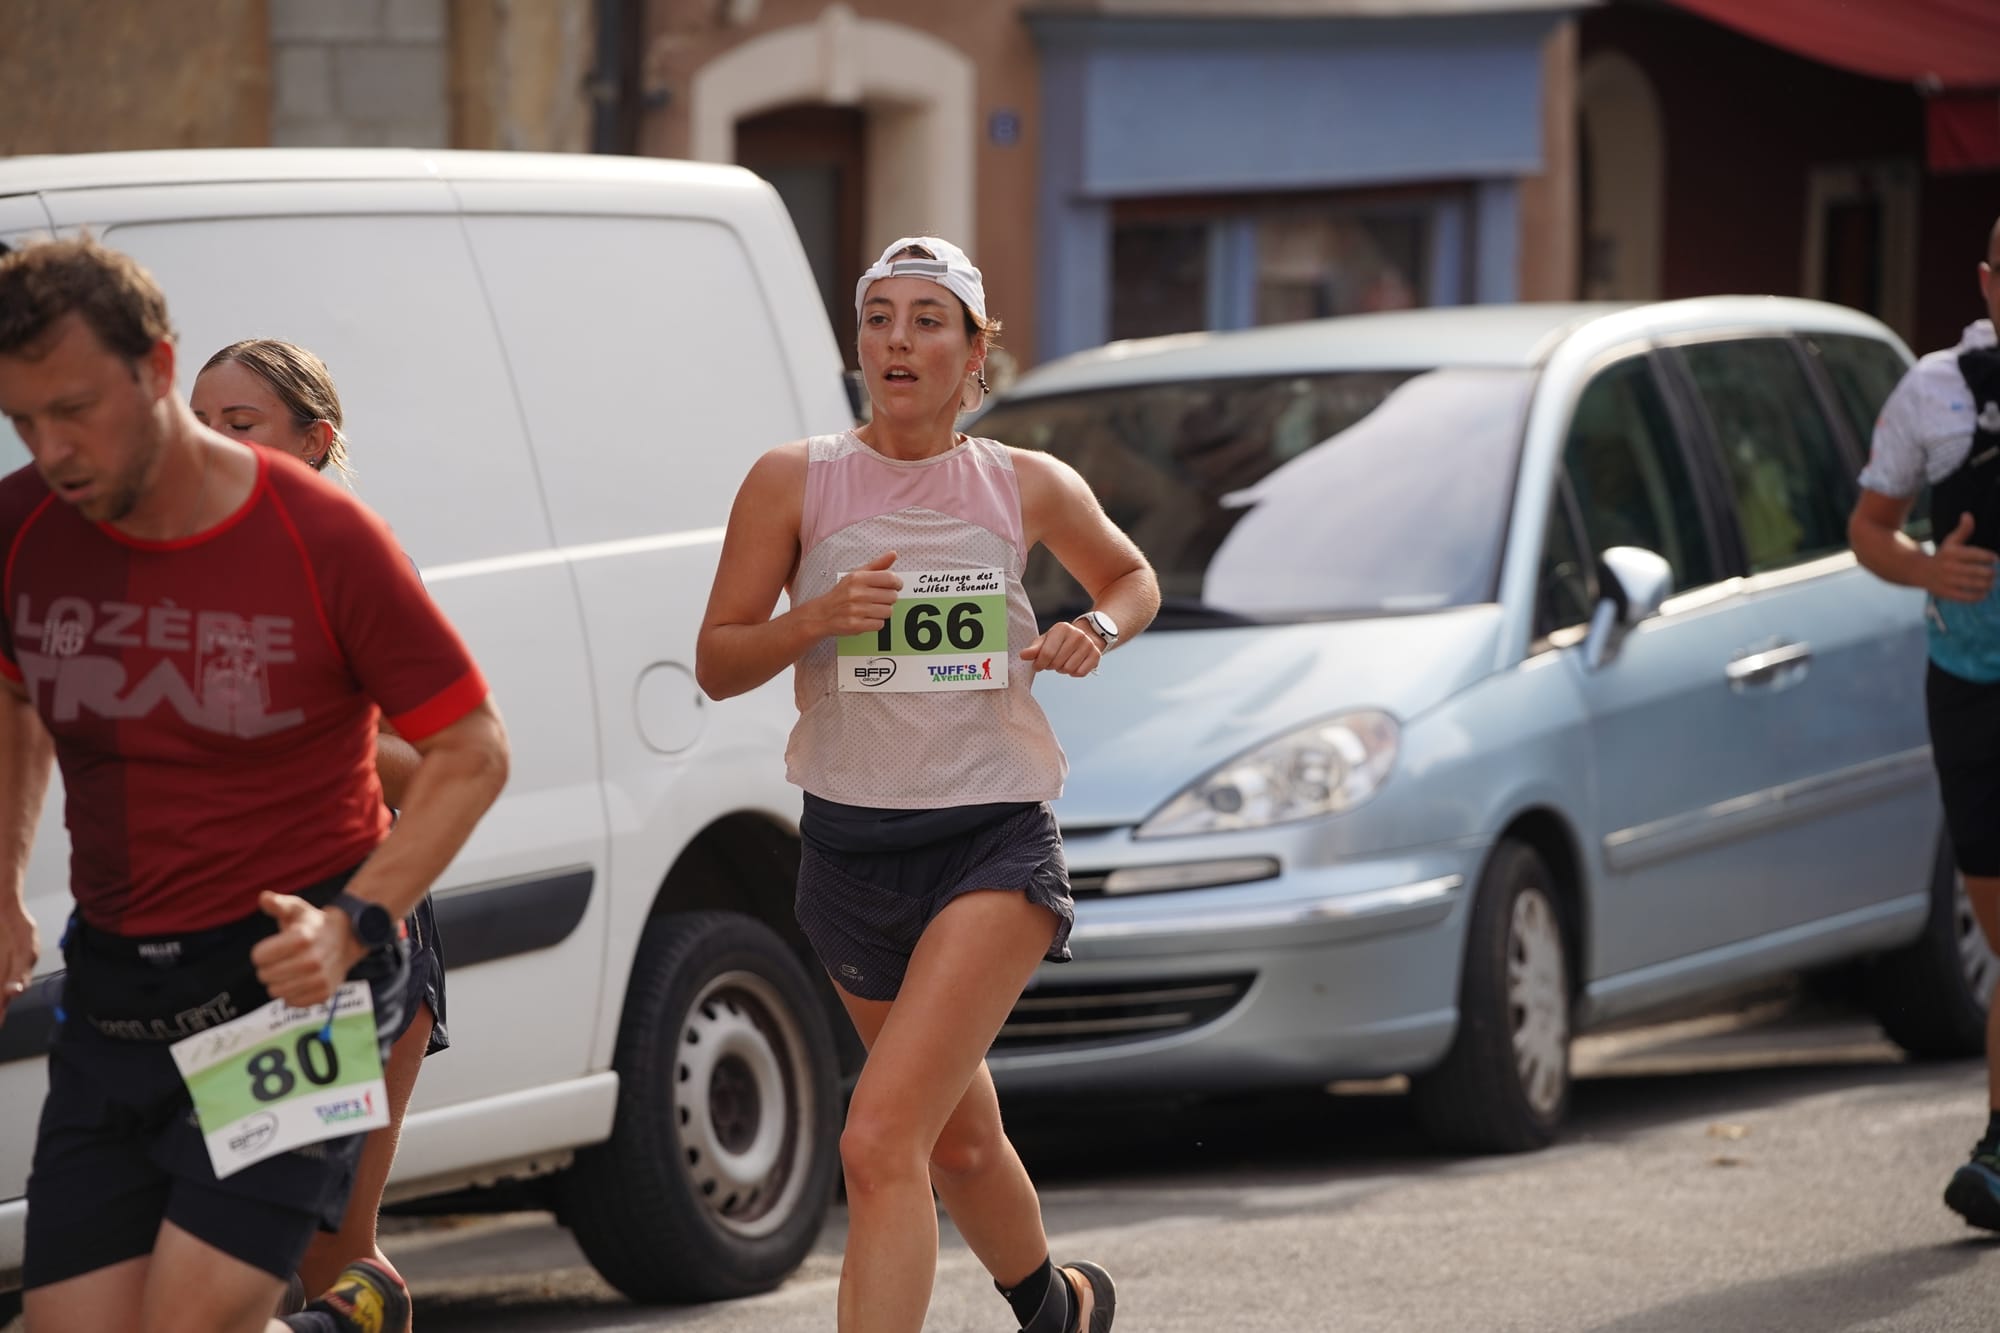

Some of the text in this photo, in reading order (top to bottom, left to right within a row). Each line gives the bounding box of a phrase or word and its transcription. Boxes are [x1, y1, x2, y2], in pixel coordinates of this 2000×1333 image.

[918, 572, 993, 585] Challenge des
[913, 582, 999, 593] vallées cévenoles
[15, 593, 296, 664] LOZÈRE
[878, 602, 985, 651] 166
[854, 667, 891, 678] BFP
[927, 664, 977, 676] TUFF'S
[932, 673, 982, 683] Aventure
[247, 1030, 339, 1102] 80
